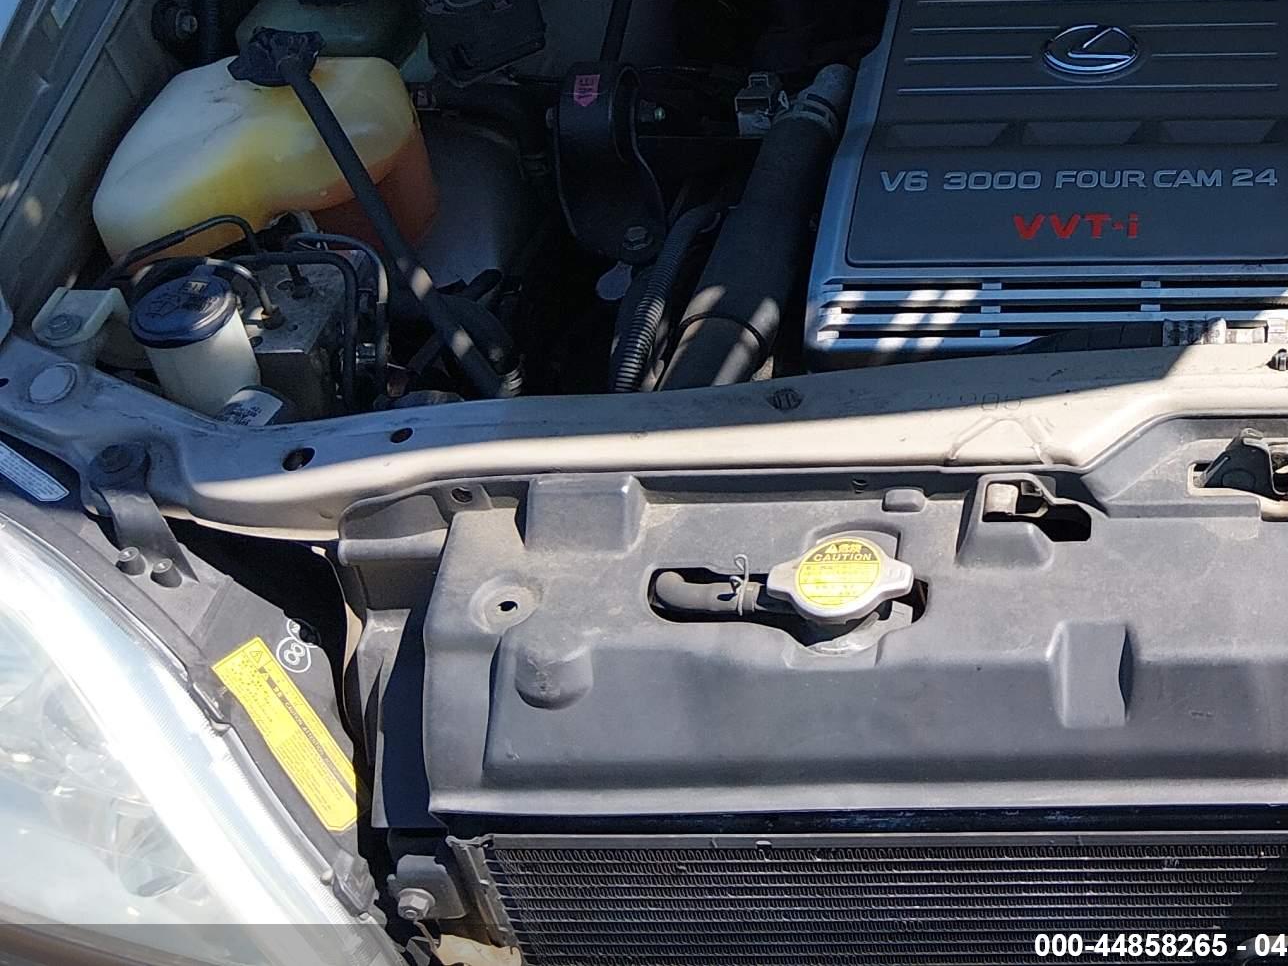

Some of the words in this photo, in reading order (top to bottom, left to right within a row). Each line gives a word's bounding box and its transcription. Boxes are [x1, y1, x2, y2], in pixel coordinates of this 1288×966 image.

[880, 170, 928, 192] V6
[943, 170, 1042, 191] 3000
[1055, 170, 1147, 190] FOUR
[1154, 169, 1223, 189] CAM
[1232, 168, 1279, 188] 24
[1012, 212, 1141, 240] VVT-i
[812, 553, 873, 562] CAUTION
